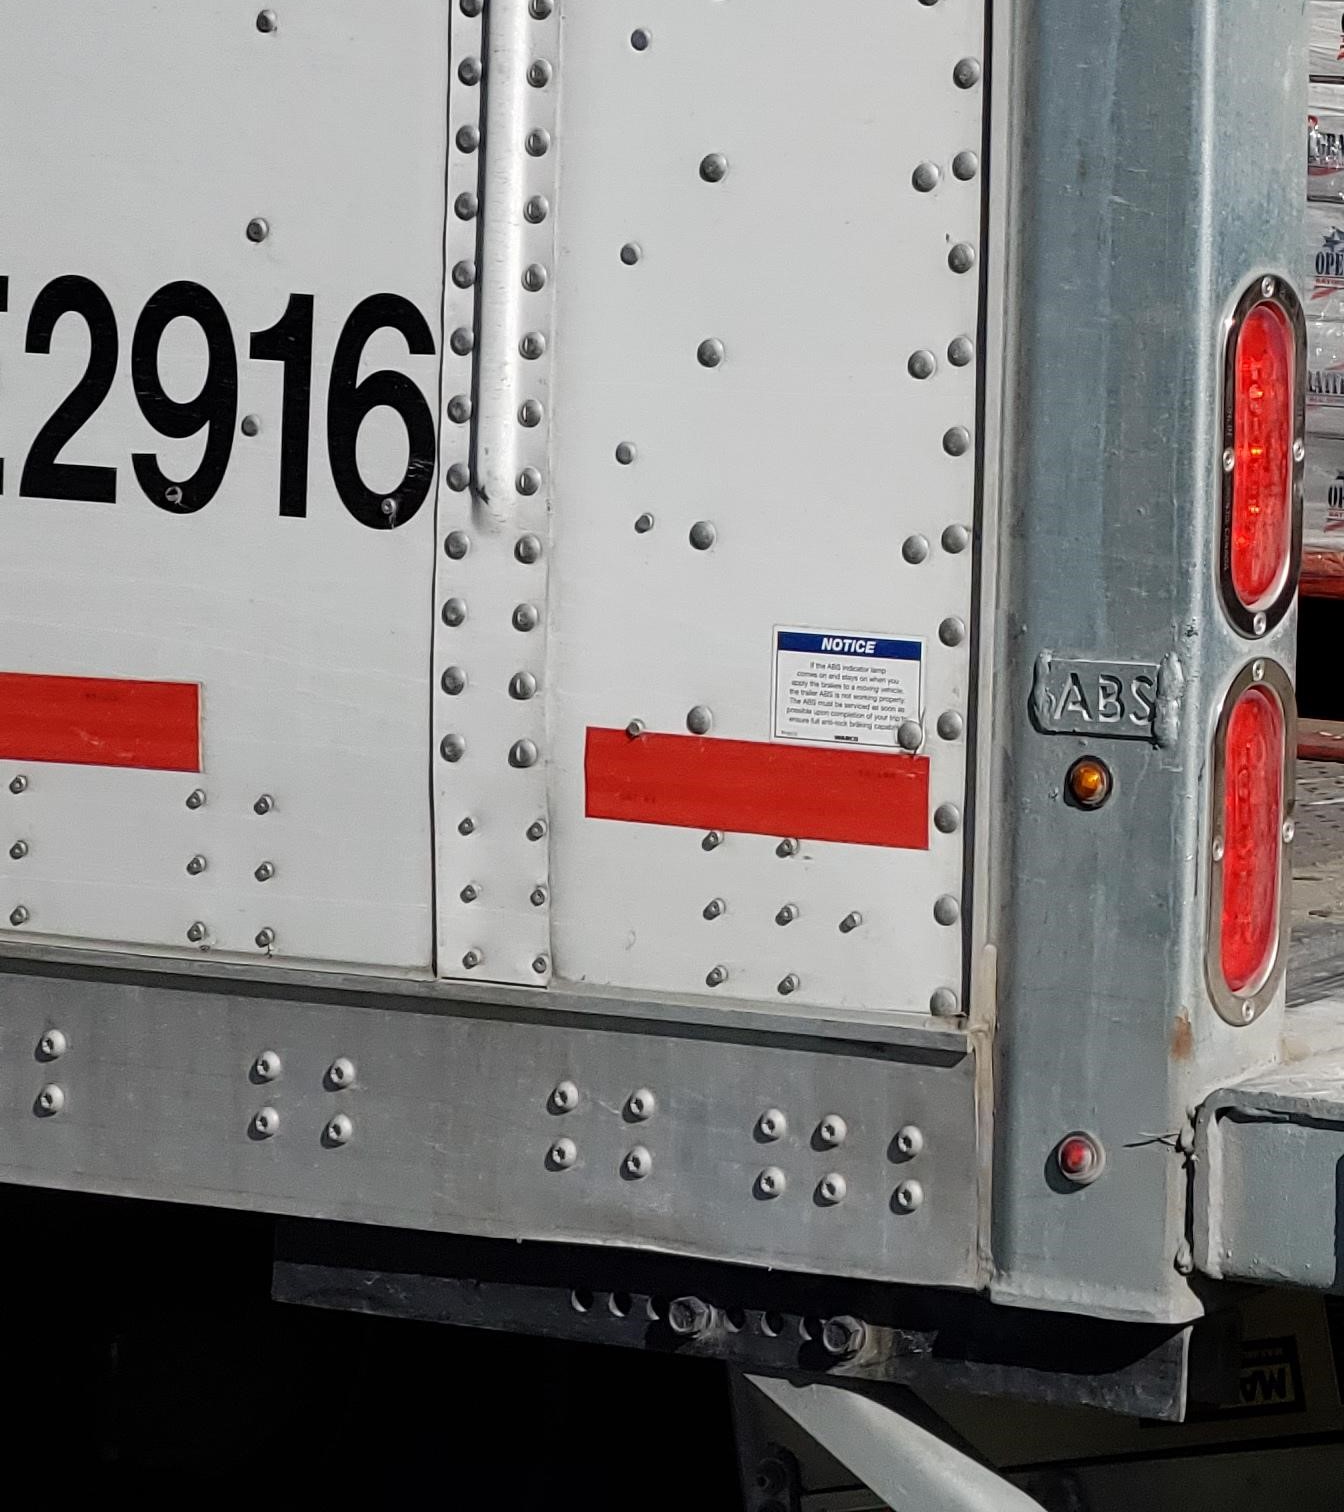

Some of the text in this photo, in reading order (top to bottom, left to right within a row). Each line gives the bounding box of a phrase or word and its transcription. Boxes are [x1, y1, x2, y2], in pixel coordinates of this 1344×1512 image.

[0, 274, 437, 530] 2916
[821, 637, 876, 653] NOTICE
[1053, 672, 1157, 726] ABS
